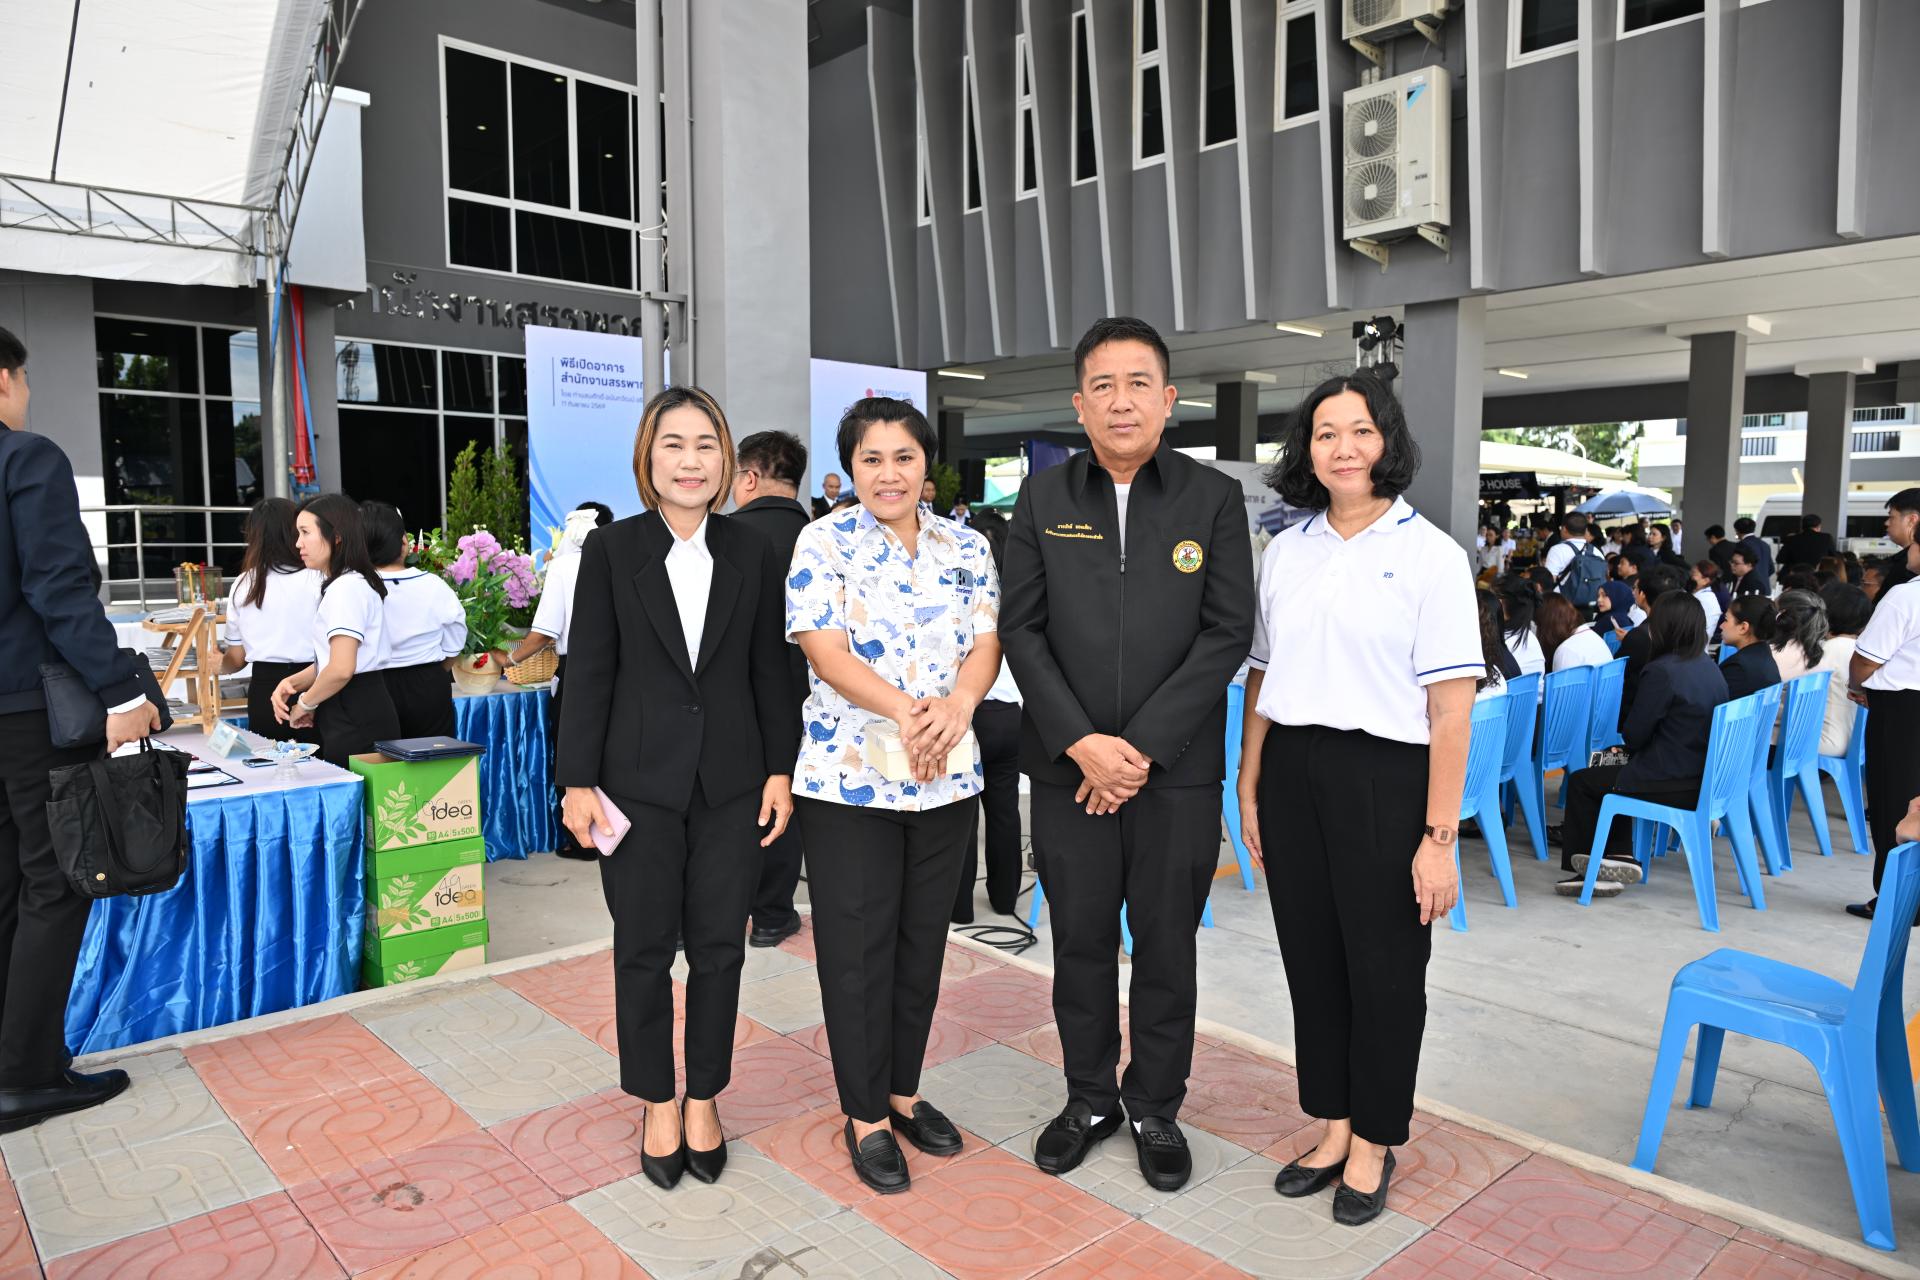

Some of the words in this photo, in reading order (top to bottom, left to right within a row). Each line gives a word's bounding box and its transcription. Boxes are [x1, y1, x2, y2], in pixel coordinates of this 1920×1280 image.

[560, 357, 625, 374] พิธีเปิดอาคาร
[1486, 478, 1522, 490] HOUSE
[1383, 571, 1394, 579] RD
[431, 802, 473, 821] idea
[438, 830, 449, 839] A4
[435, 888, 476, 907] idea
[442, 916, 453, 924] A4
